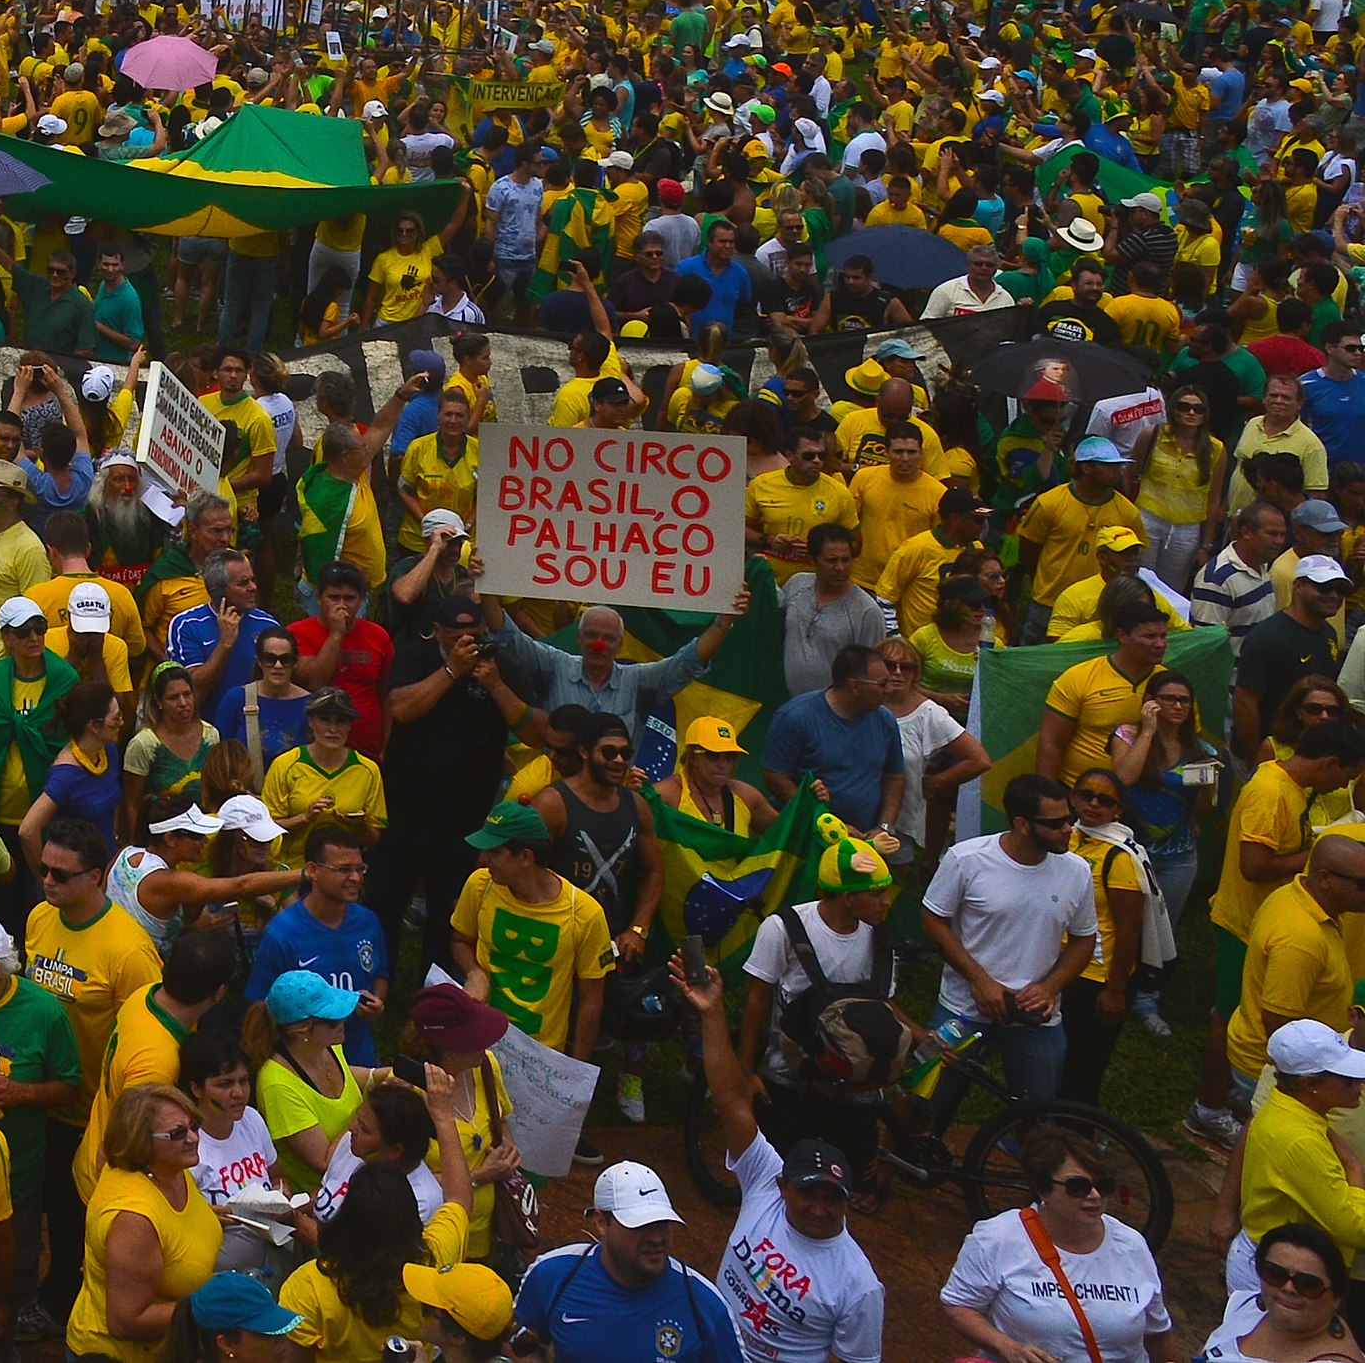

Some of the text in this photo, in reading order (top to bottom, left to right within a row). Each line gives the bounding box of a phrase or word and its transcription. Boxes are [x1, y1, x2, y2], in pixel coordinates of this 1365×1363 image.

[472, 81, 562, 105] INTERVENÇÃO
[73, 108, 88, 136] 9
[160, 423, 204, 476] ABAIXO O
[508, 435, 733, 484] NO CIRCO
[671, 485, 712, 521] O
[507, 514, 716, 558] PALHAÇO
[532, 553, 712, 597] SOU EU
[34, 967, 75, 998] BRASIL
[41, 957, 75, 978] LIMPA
[218, 1151, 267, 1193] FORA
[753, 1237, 811, 1300] FORA
[1031, 1280, 1133, 1303] IMPECHMENT
